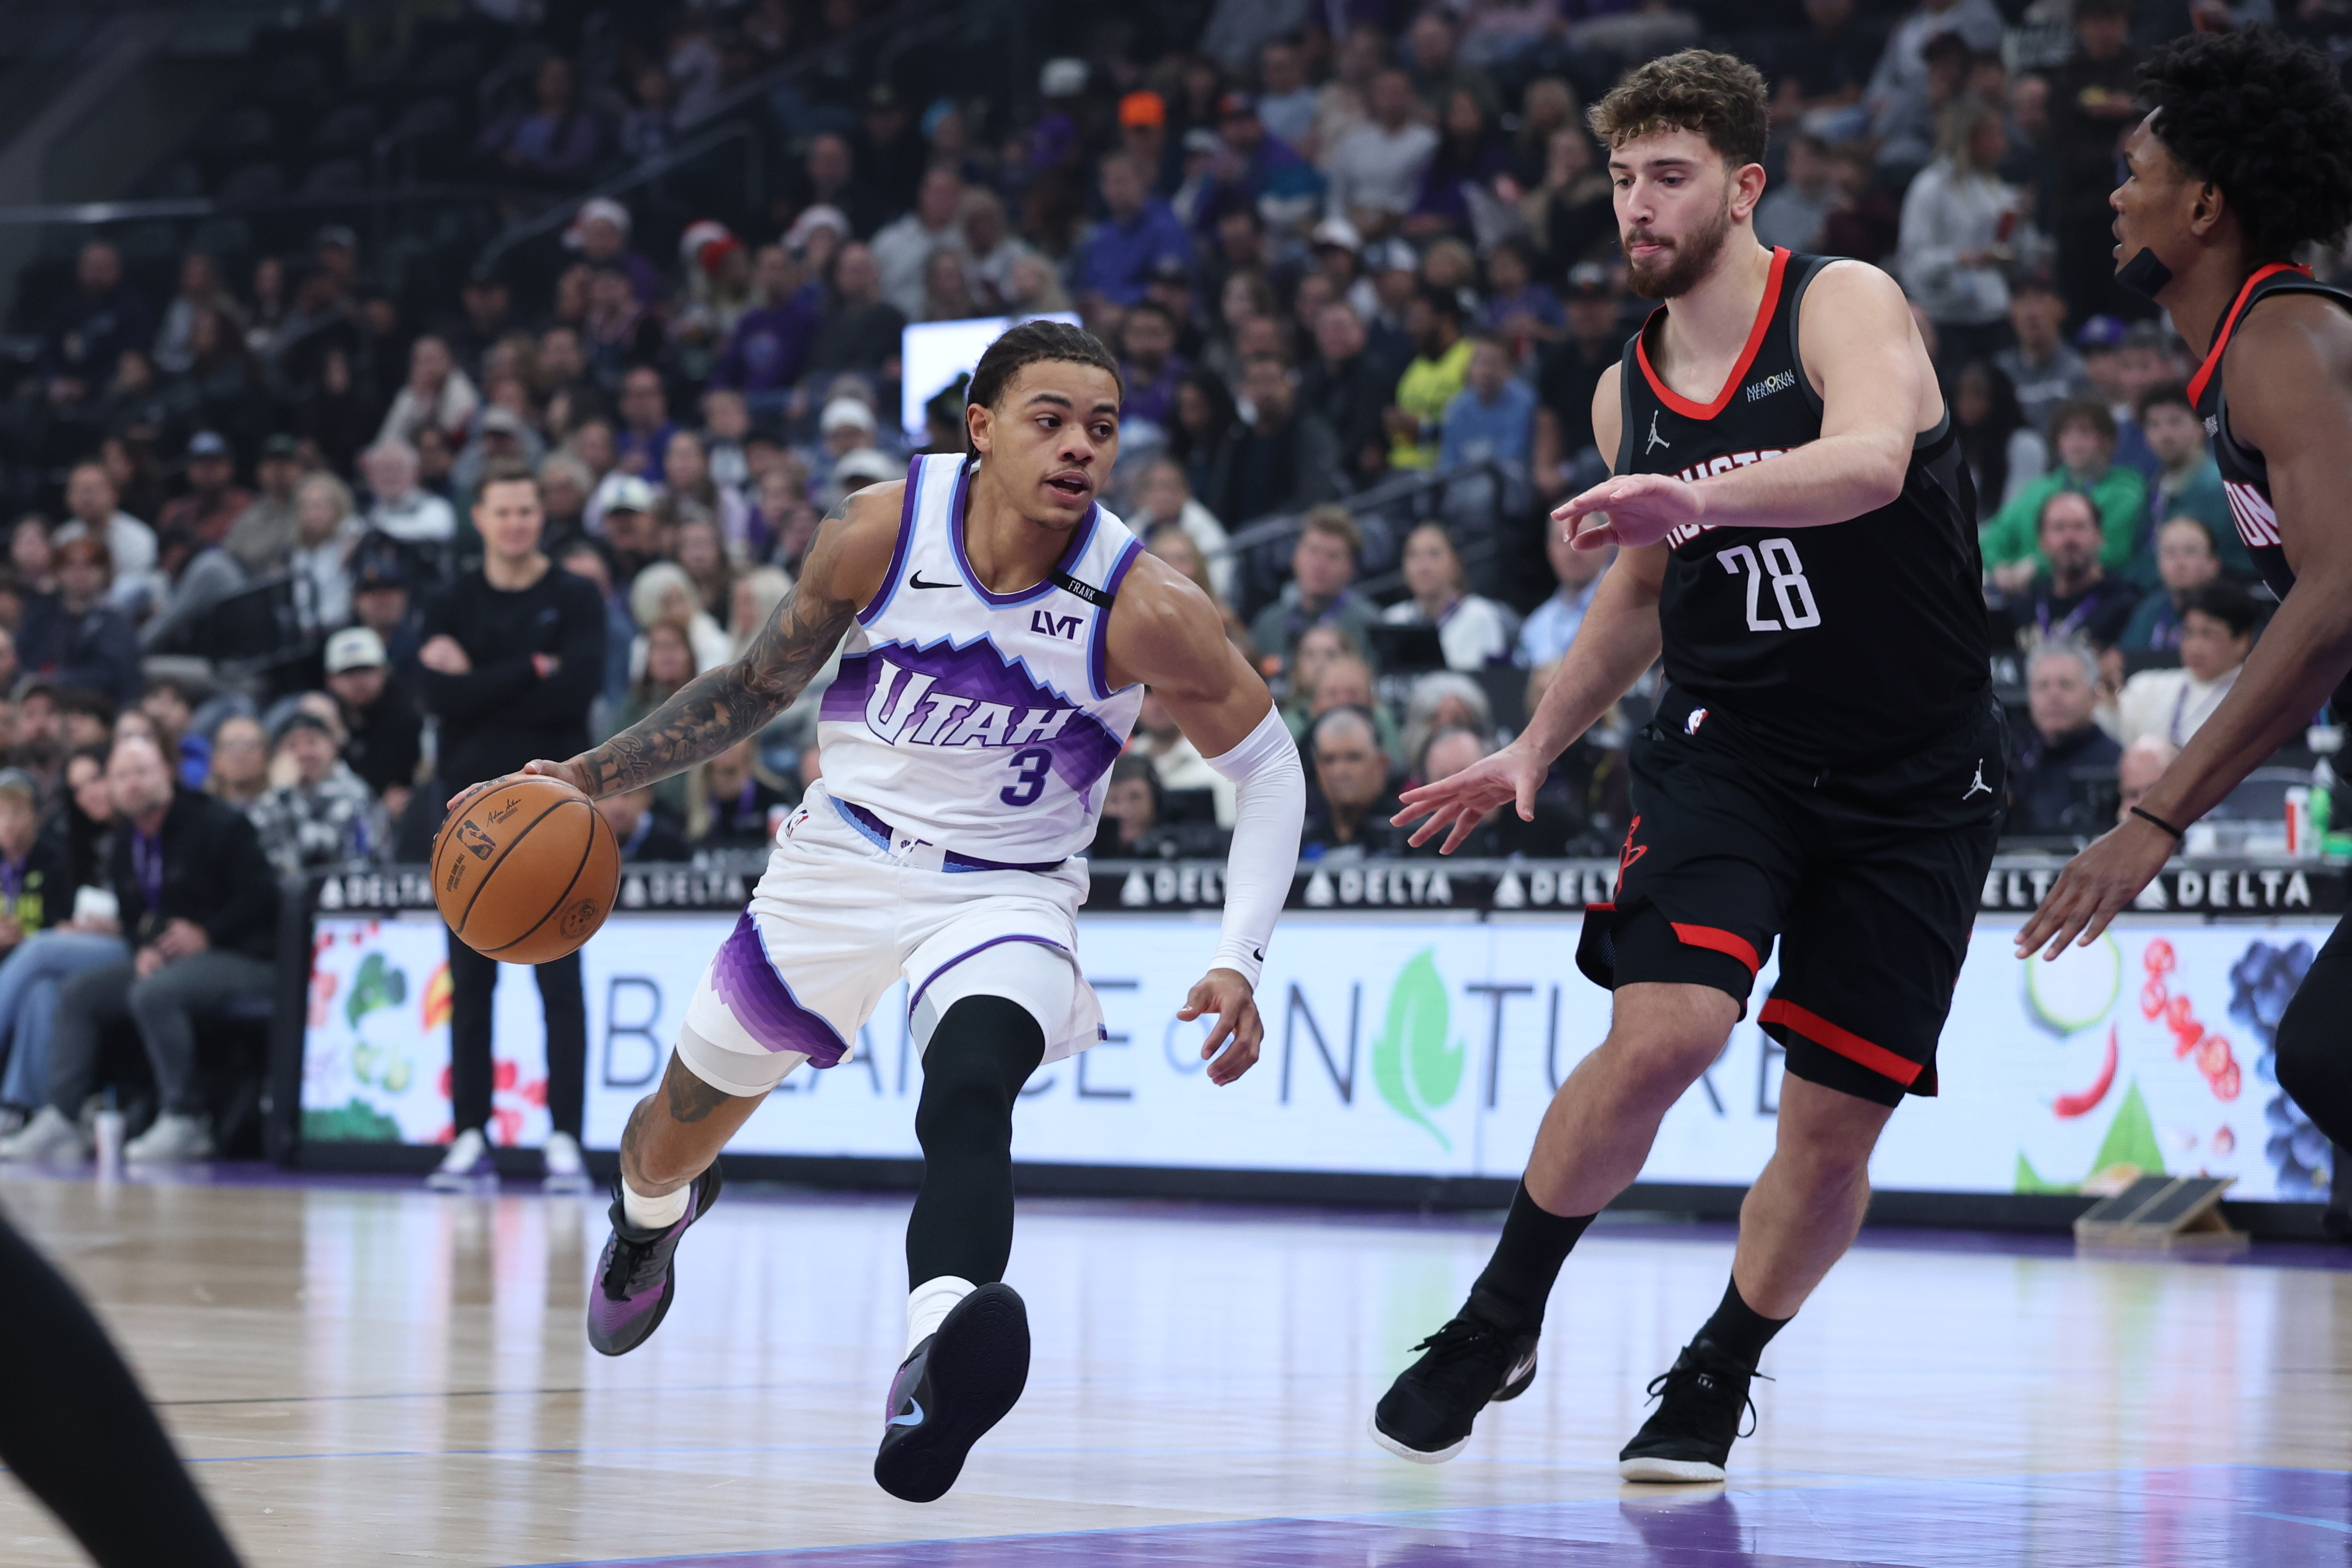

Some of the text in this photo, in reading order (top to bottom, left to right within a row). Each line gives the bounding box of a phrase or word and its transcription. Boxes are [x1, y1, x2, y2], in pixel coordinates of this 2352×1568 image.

[1746, 369, 1794, 393] MEMORIAL
[1747, 375, 1795, 402] HERMANN
[1068, 580, 1095, 601] FRANK
[1716, 537, 1821, 632] 28
[1031, 610, 1084, 640] LVT
[865, 657, 1081, 746] UTAH
[1000, 748, 1054, 806] 3
[1339, 868, 1454, 905] DELTA
[2177, 869, 2312, 907] DELTA
